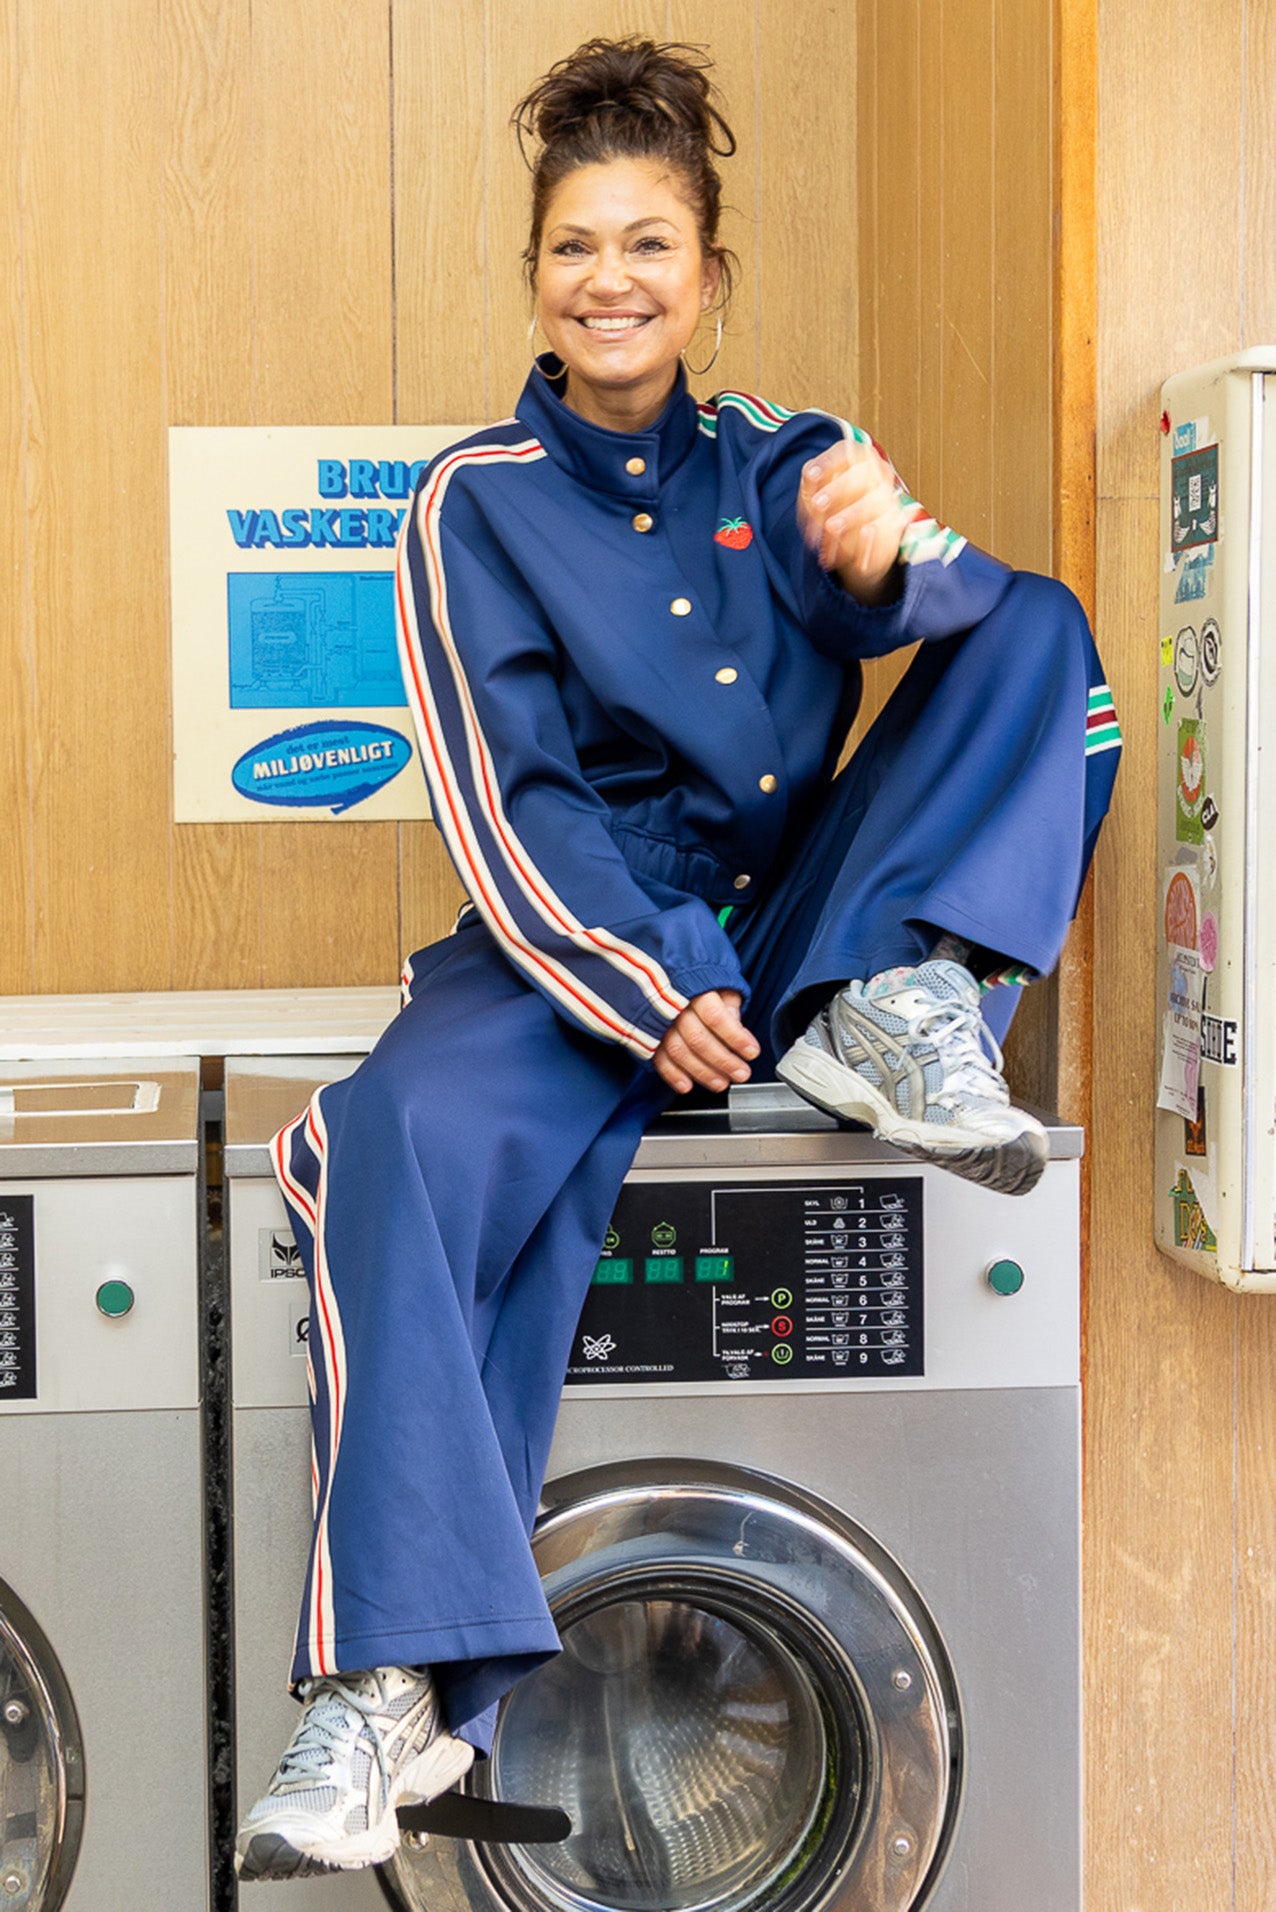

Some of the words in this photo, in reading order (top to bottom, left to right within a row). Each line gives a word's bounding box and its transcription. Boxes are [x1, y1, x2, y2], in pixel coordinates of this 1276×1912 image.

[253, 741, 395, 781] MILJØVENLIGT
[858, 1198, 865, 1209] 1
[858, 1217, 866, 1229] 2
[858, 1236, 867, 1248] 3
[700, 1247, 729, 1255] PROGRAM
[858, 1256, 866, 1267] 4
[859, 1275, 867, 1286] 5
[777, 1294, 786, 1303] P
[859, 1294, 867, 1306] 6
[859, 1314, 867, 1325] 7
[778, 1321, 786, 1331] S
[859, 1333, 868, 1345] 8
[859, 1352, 868, 1364] 9
[567, 1365, 624, 1374] CROPROCESSOR
